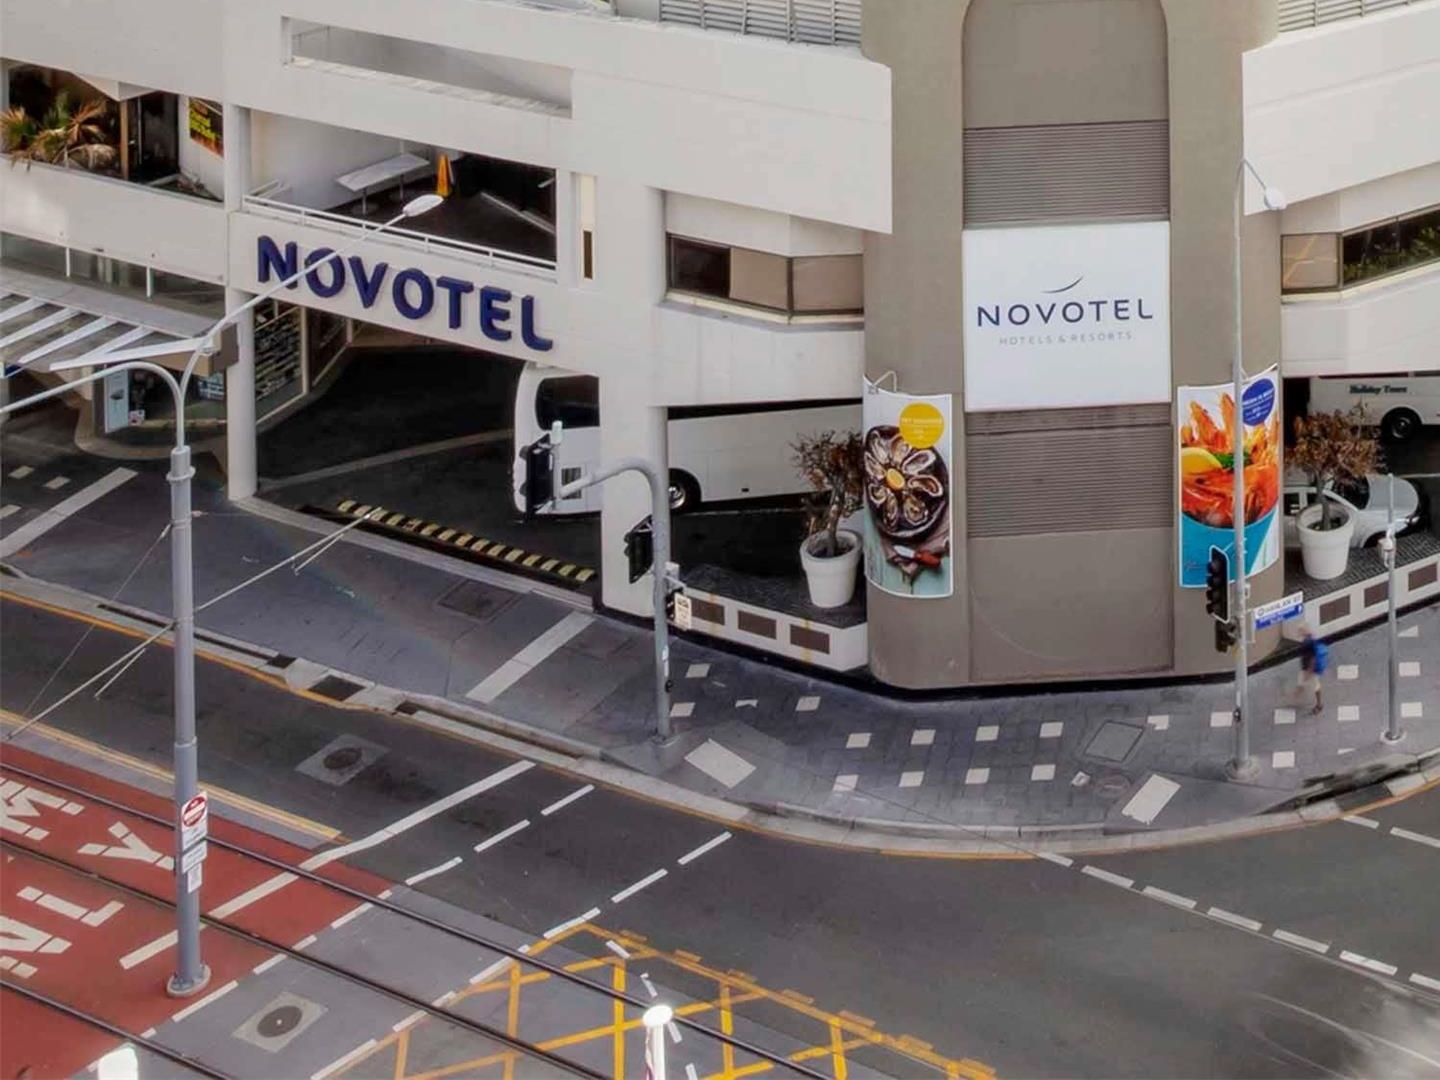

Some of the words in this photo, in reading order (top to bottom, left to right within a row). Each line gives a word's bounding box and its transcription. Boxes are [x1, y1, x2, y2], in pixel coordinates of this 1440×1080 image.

[257, 235, 553, 352] NOVOTEL
[977, 298, 1153, 327] NOVOTEL
[1000, 334, 1051, 346] HOTELS
[1071, 331, 1133, 343] RESORTS
